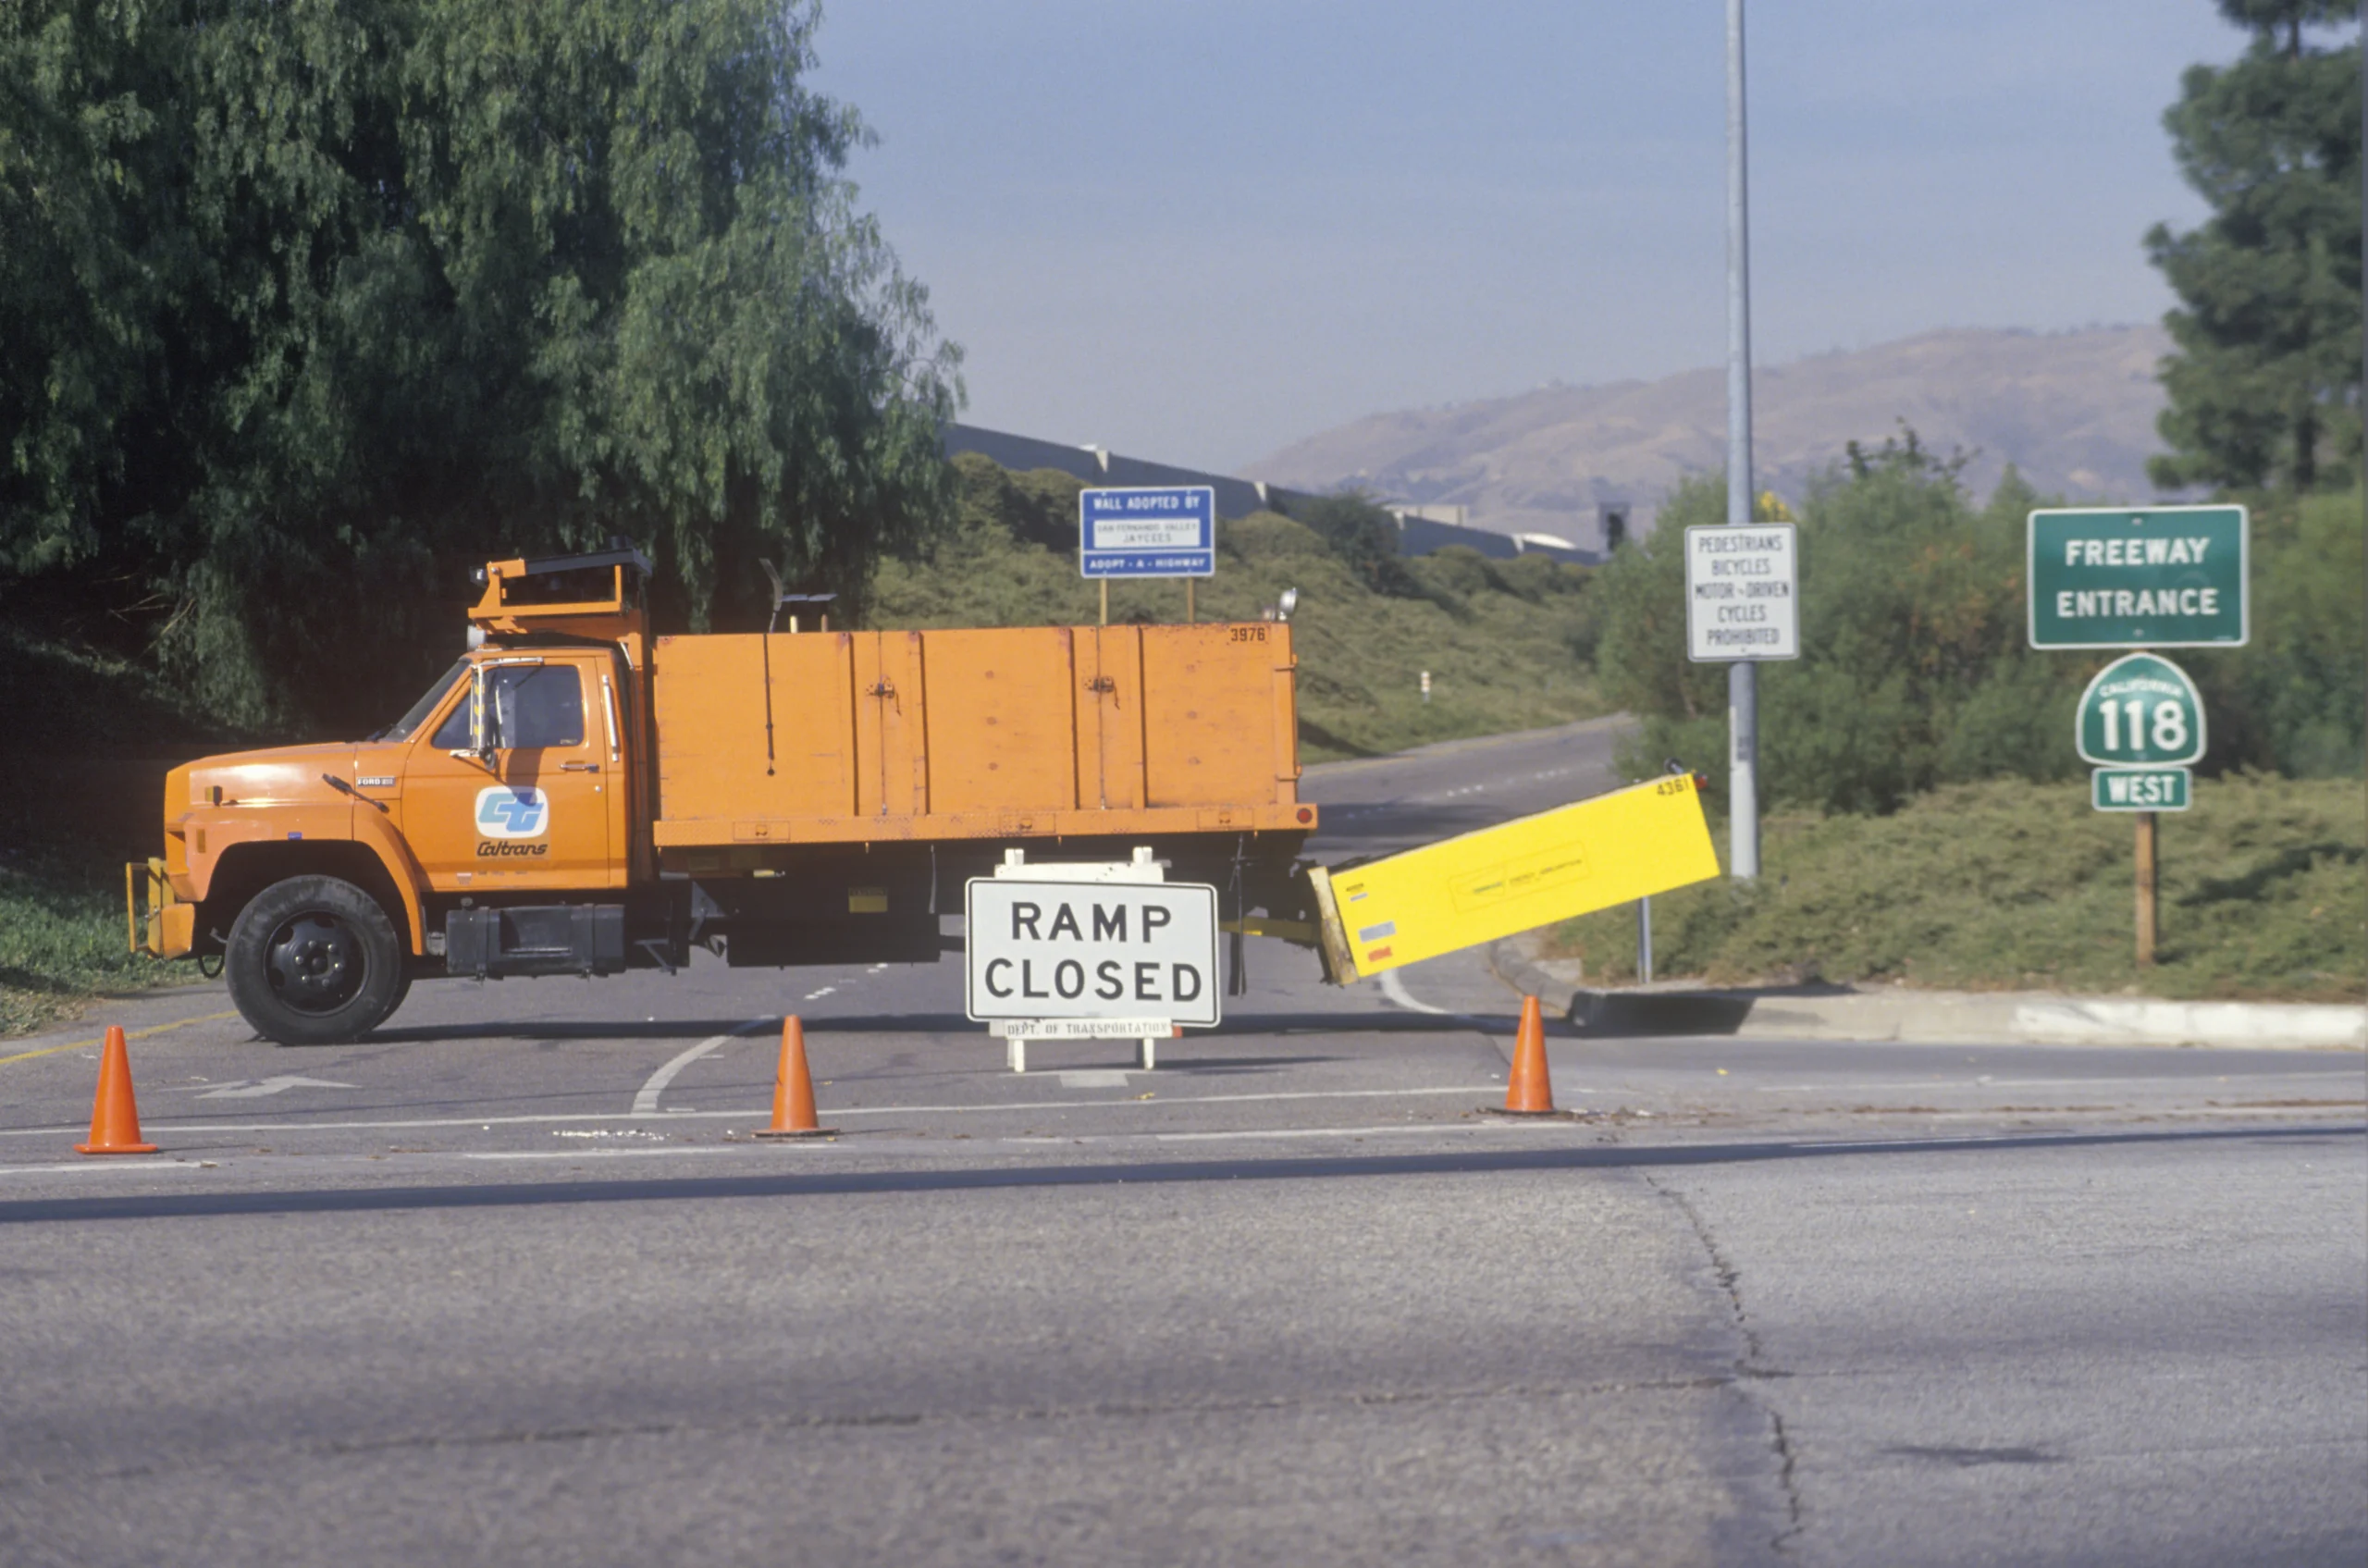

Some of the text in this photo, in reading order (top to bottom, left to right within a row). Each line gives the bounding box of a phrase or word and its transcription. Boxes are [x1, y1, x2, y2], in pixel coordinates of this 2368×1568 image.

[1093, 495, 1201, 510] WALL ADOPTED BY
[1165, 523, 1197, 531] VALLEY
[1123, 533, 1172, 544] JAYCEES
[1698, 535, 1782, 553] PEDESTRIANS
[2066, 537, 2210, 566] FREEWAY
[1711, 558, 1770, 576] BICYCLES
[2056, 588, 2220, 618] ENTRANCE
[1718, 604, 1767, 623] CYCLES
[1230, 627, 1265, 642] 3976
[1707, 627, 1780, 646] PROHIBITED
[2099, 677, 2185, 699] CALIFORNIA
[2098, 699, 2189, 752] 118
[358, 778, 381, 786] FORD
[1657, 778, 1689, 796] 4361
[2106, 774, 2177, 804] WEST
[476, 841, 548, 857] Caltrans
[1011, 901, 1171, 944] RAMP
[985, 957, 1202, 1002] CLOSED
[1045, 1024, 1058, 1034] OF
